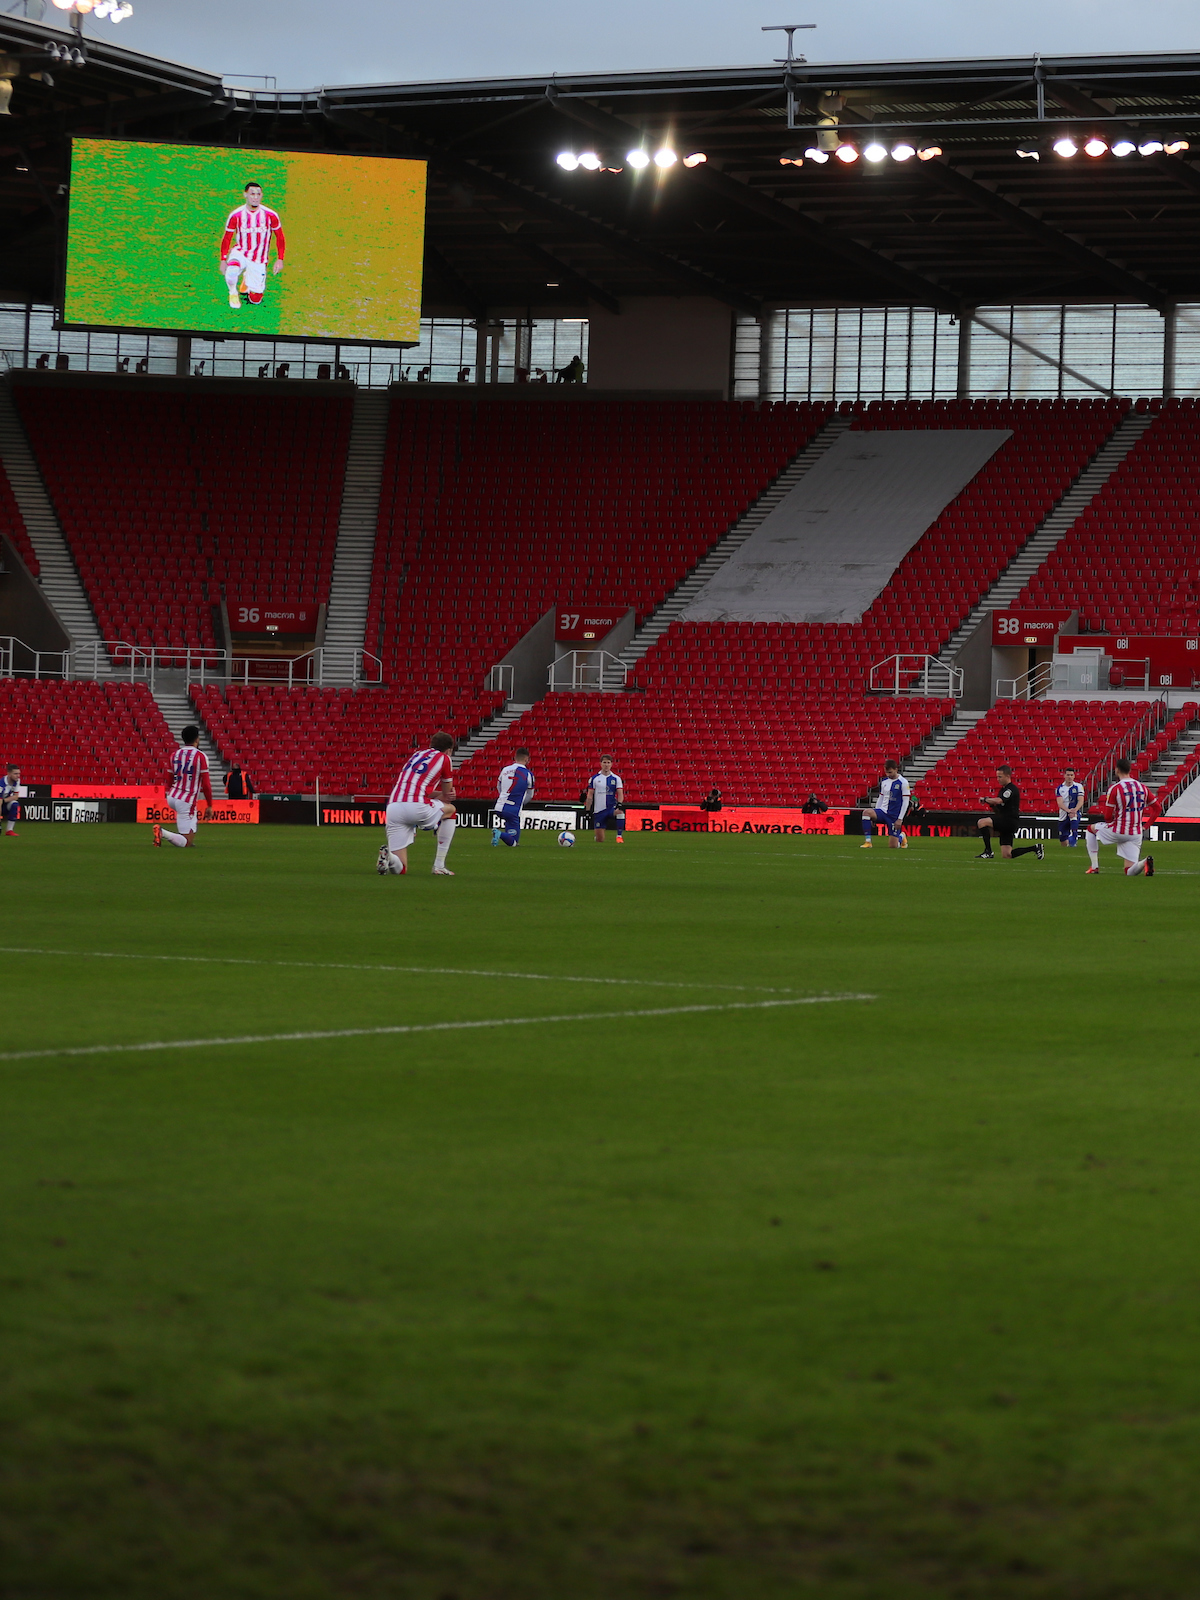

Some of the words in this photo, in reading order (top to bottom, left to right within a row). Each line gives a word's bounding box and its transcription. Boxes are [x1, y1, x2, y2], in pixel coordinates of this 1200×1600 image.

[238, 607, 260, 623] 36
[560, 614, 580, 629] 37
[997, 618, 1019, 634] 38
[508, 776, 520, 794] 7
[24, 806, 51, 820] YOU'LL
[55, 806, 71, 820] BET
[323, 809, 364, 823] THINK
[454, 813, 484, 828] OU'LL
[524, 818, 571, 830] REGRET
[641, 818, 829, 835] BeGambleAware.org
[1162, 829, 1175, 841] IT
